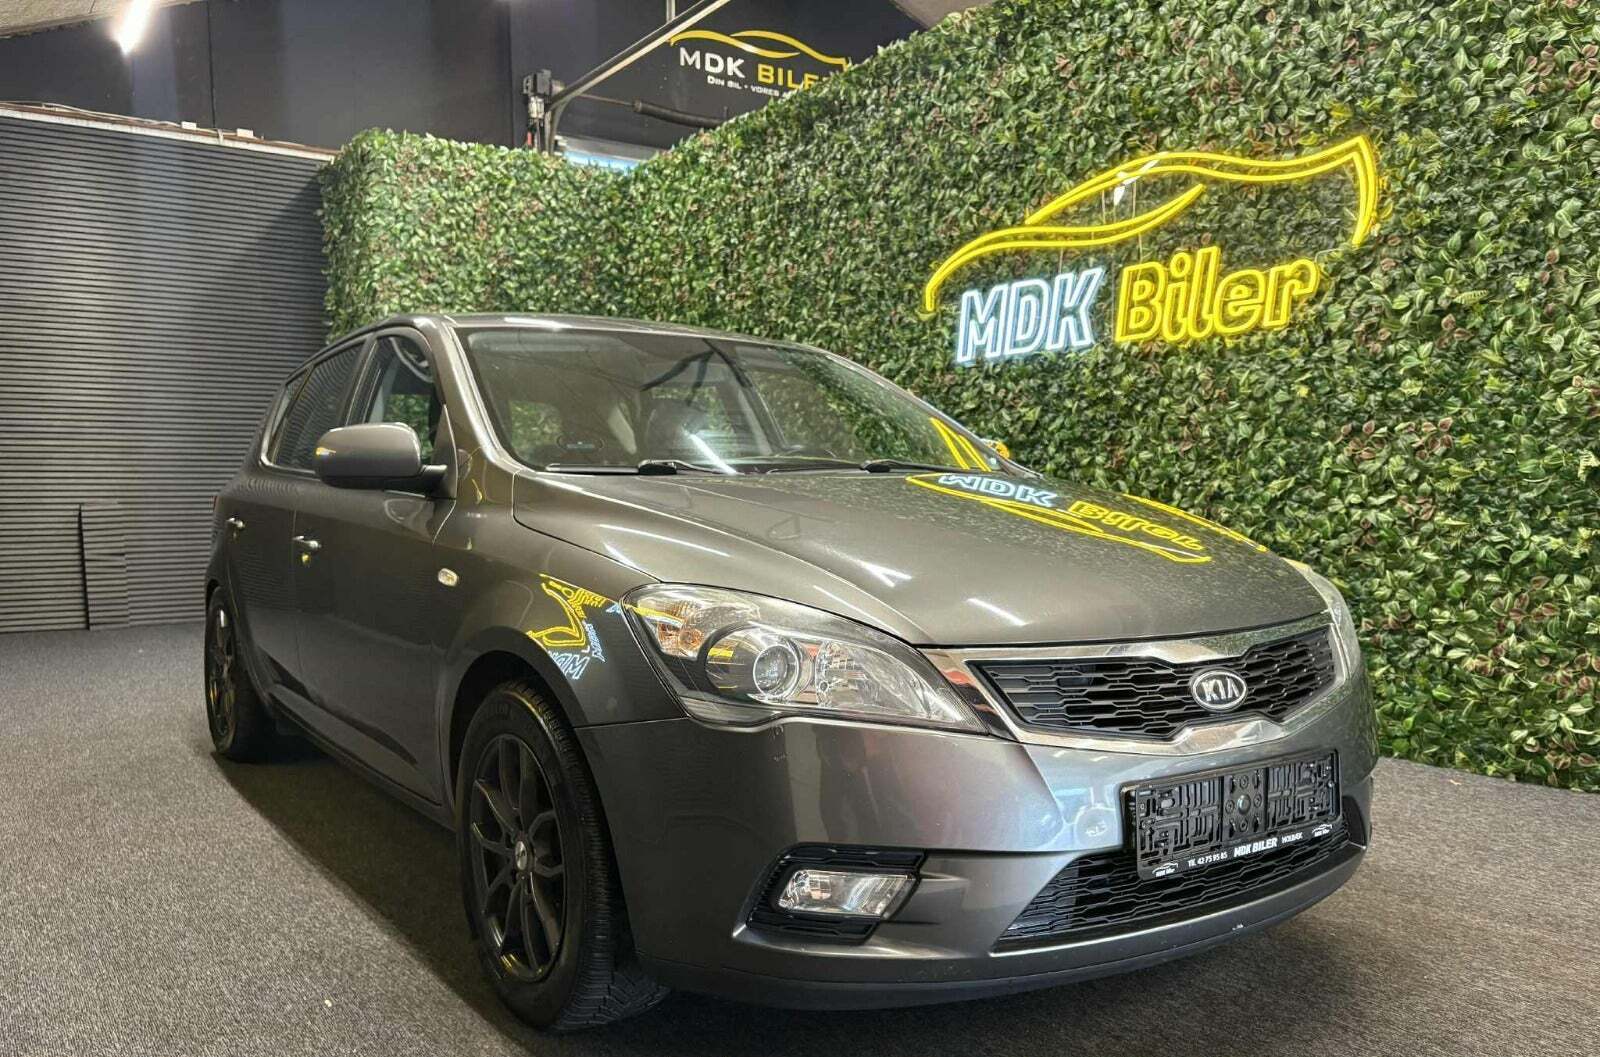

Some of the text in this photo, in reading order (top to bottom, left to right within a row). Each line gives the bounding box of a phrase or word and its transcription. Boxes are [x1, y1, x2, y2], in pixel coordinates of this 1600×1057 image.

[680, 47, 830, 90] MDK BILE
[707, 75, 725, 86] DIN
[957, 245, 1320, 363] MDK Biler
[1201, 676, 1240, 702] KIA
[1233, 843, 1251, 857] MDK
[1252, 837, 1278, 853] BILER
